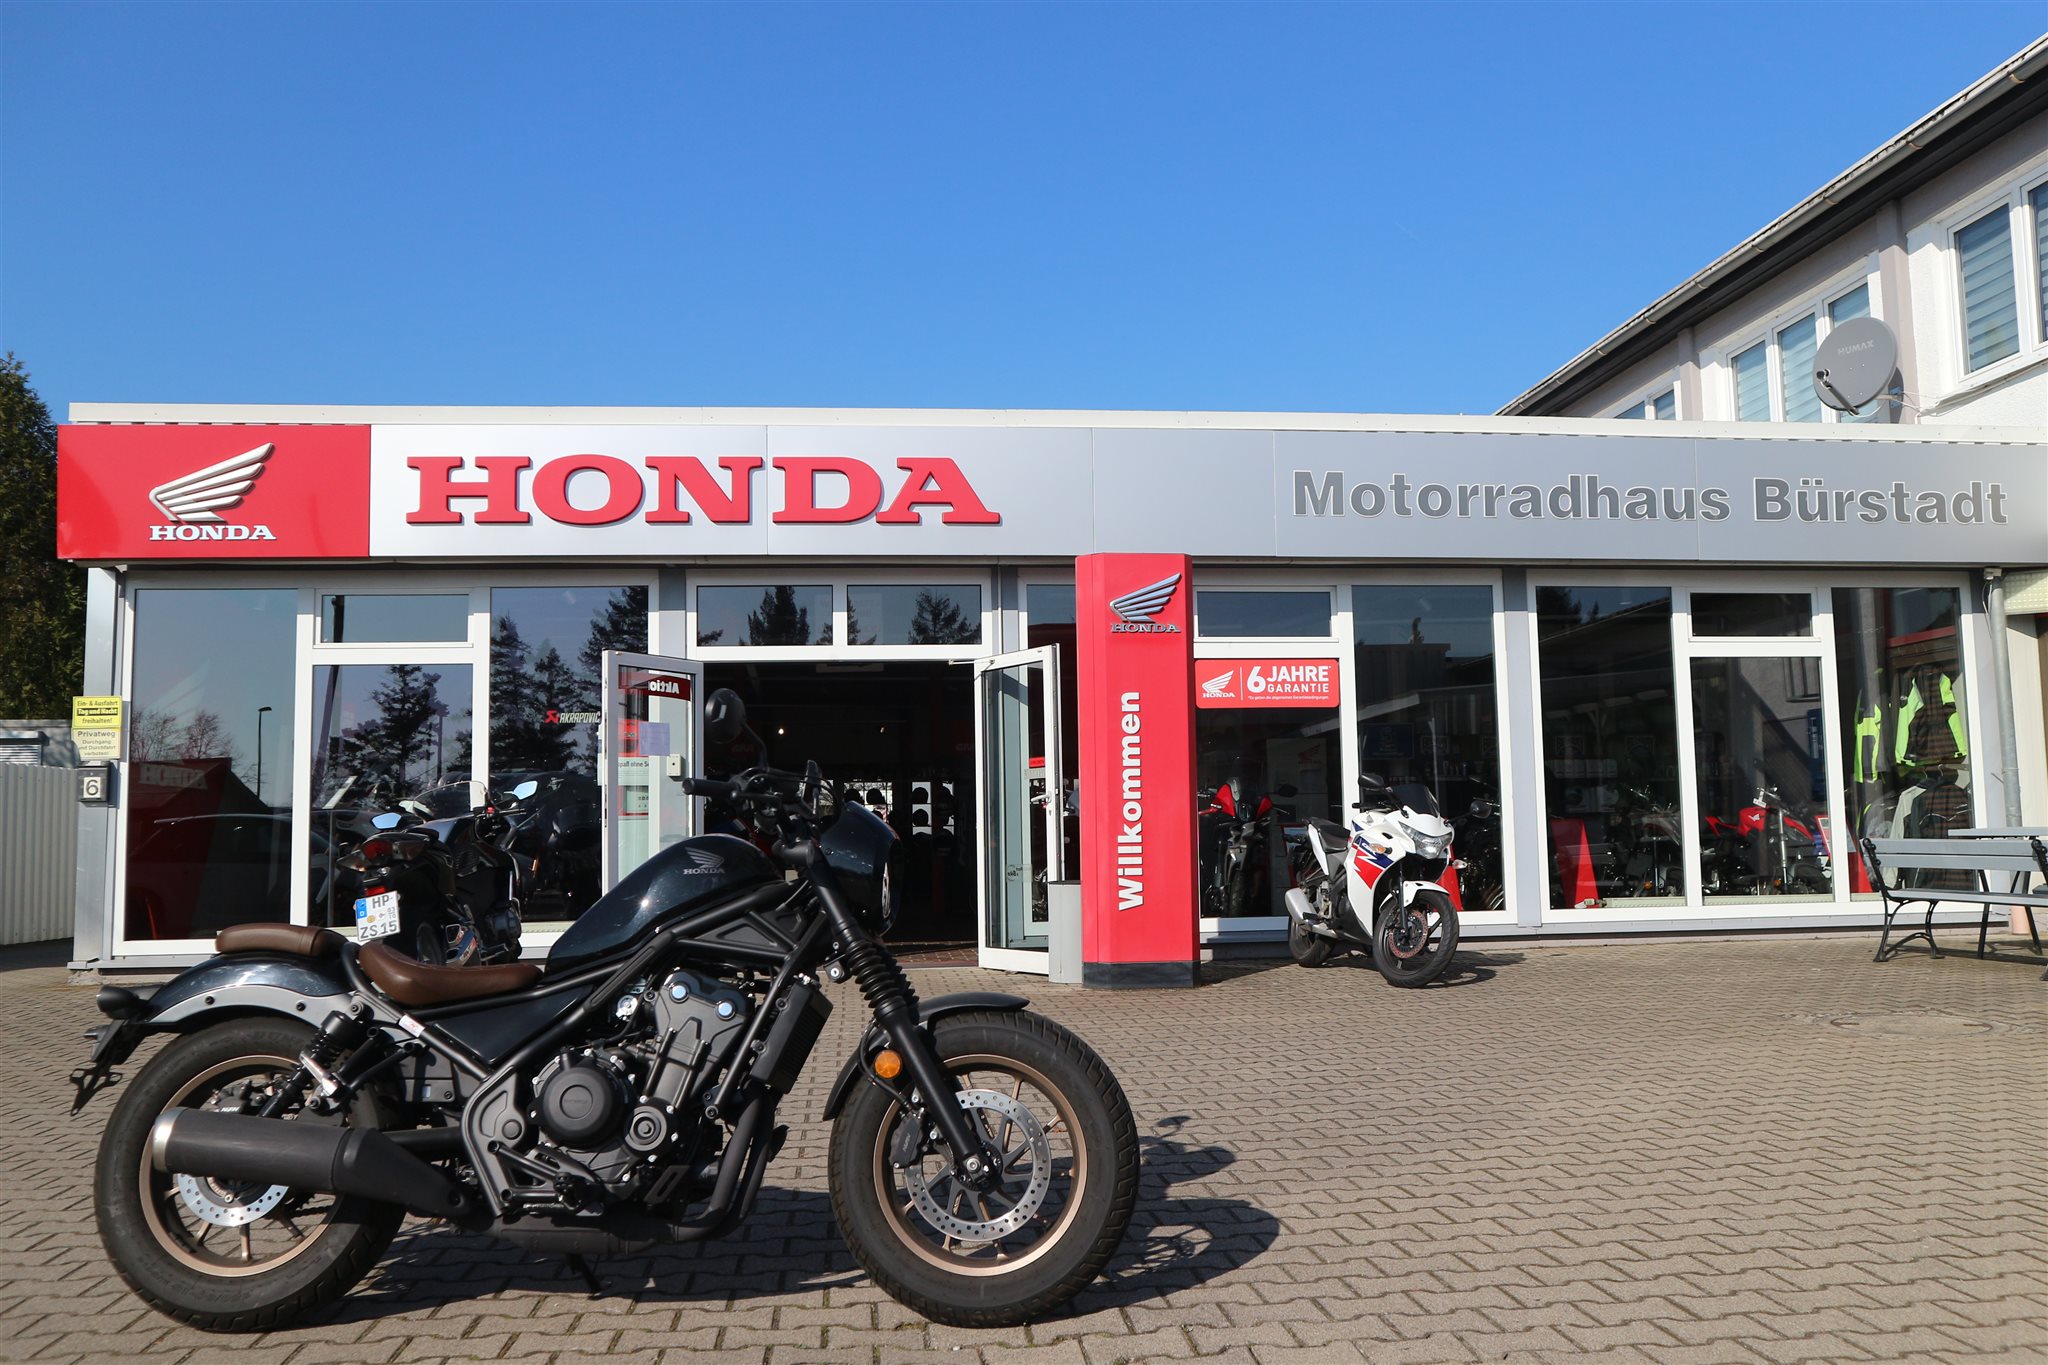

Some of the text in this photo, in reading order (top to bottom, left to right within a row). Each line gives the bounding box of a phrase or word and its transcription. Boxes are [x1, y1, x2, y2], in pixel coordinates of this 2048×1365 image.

[1838, 340, 1875, 355] HUMAX
[405, 453, 1001, 526] HONDA
[1292, 469, 2008, 526] Motorradhaus Bürstadt
[149, 525, 276, 540] HONDA
[1111, 623, 1181, 633] HONDA
[1246, 665, 1267, 693] 6
[1267, 684, 1330, 693] GARANTIE
[85, 779, 99, 796] 6
[1117, 691, 1144, 911] Willkommen
[683, 867, 726, 875] HONDA
